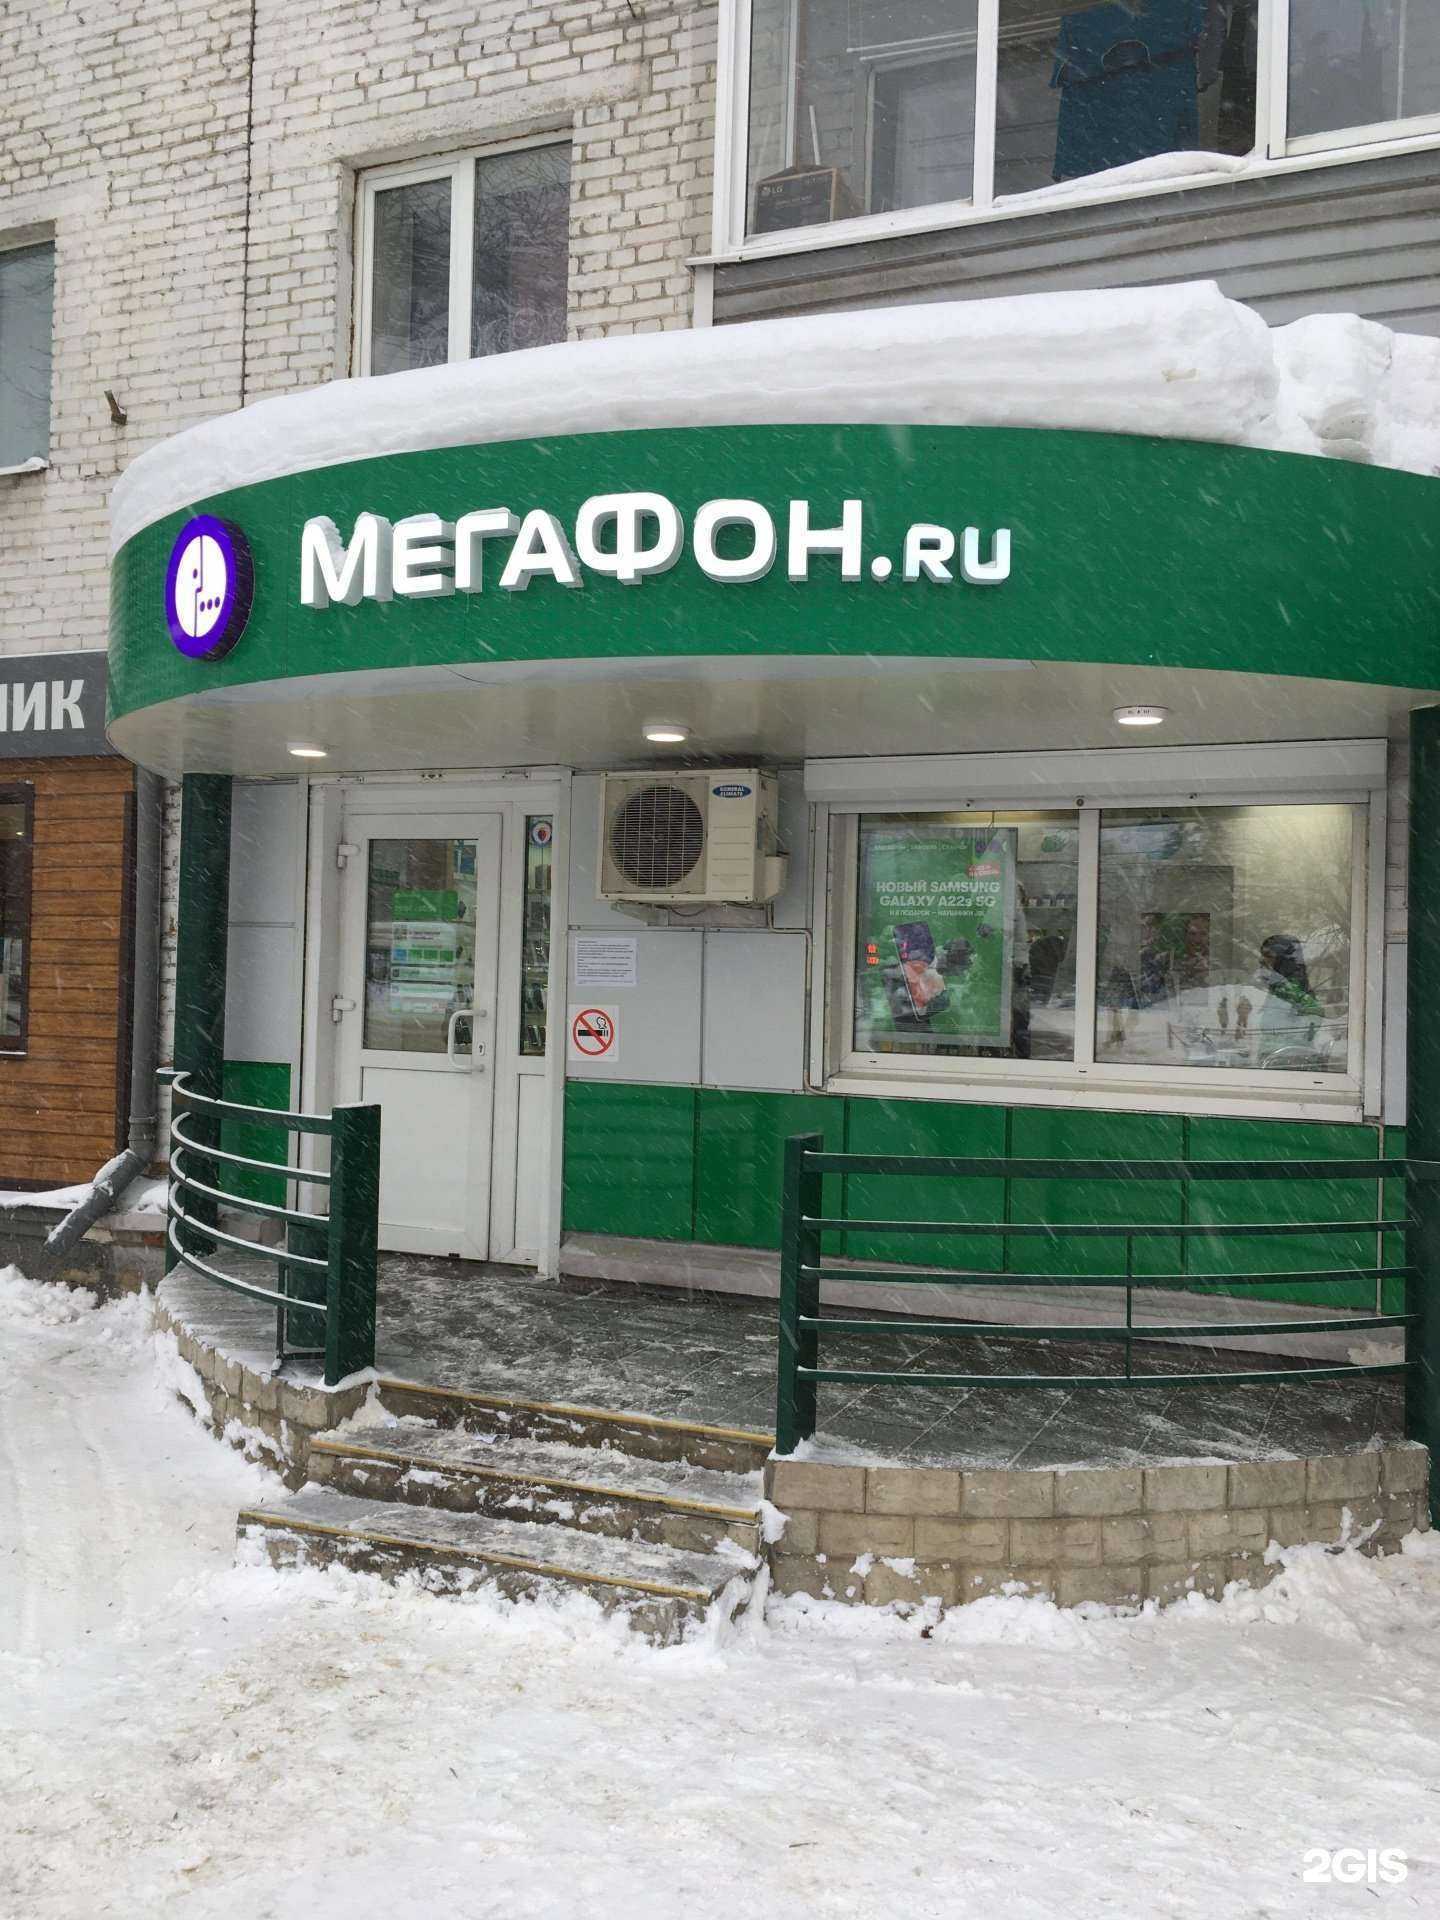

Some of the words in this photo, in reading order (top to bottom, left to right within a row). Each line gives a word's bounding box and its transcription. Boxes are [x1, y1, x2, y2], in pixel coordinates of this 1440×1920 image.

[876, 880, 928, 893] НОВЫЙ
[930, 881, 1000, 893] SAMSUNG
[879, 895, 935, 906] GALAXY
[975, 896, 996, 907] 5G
